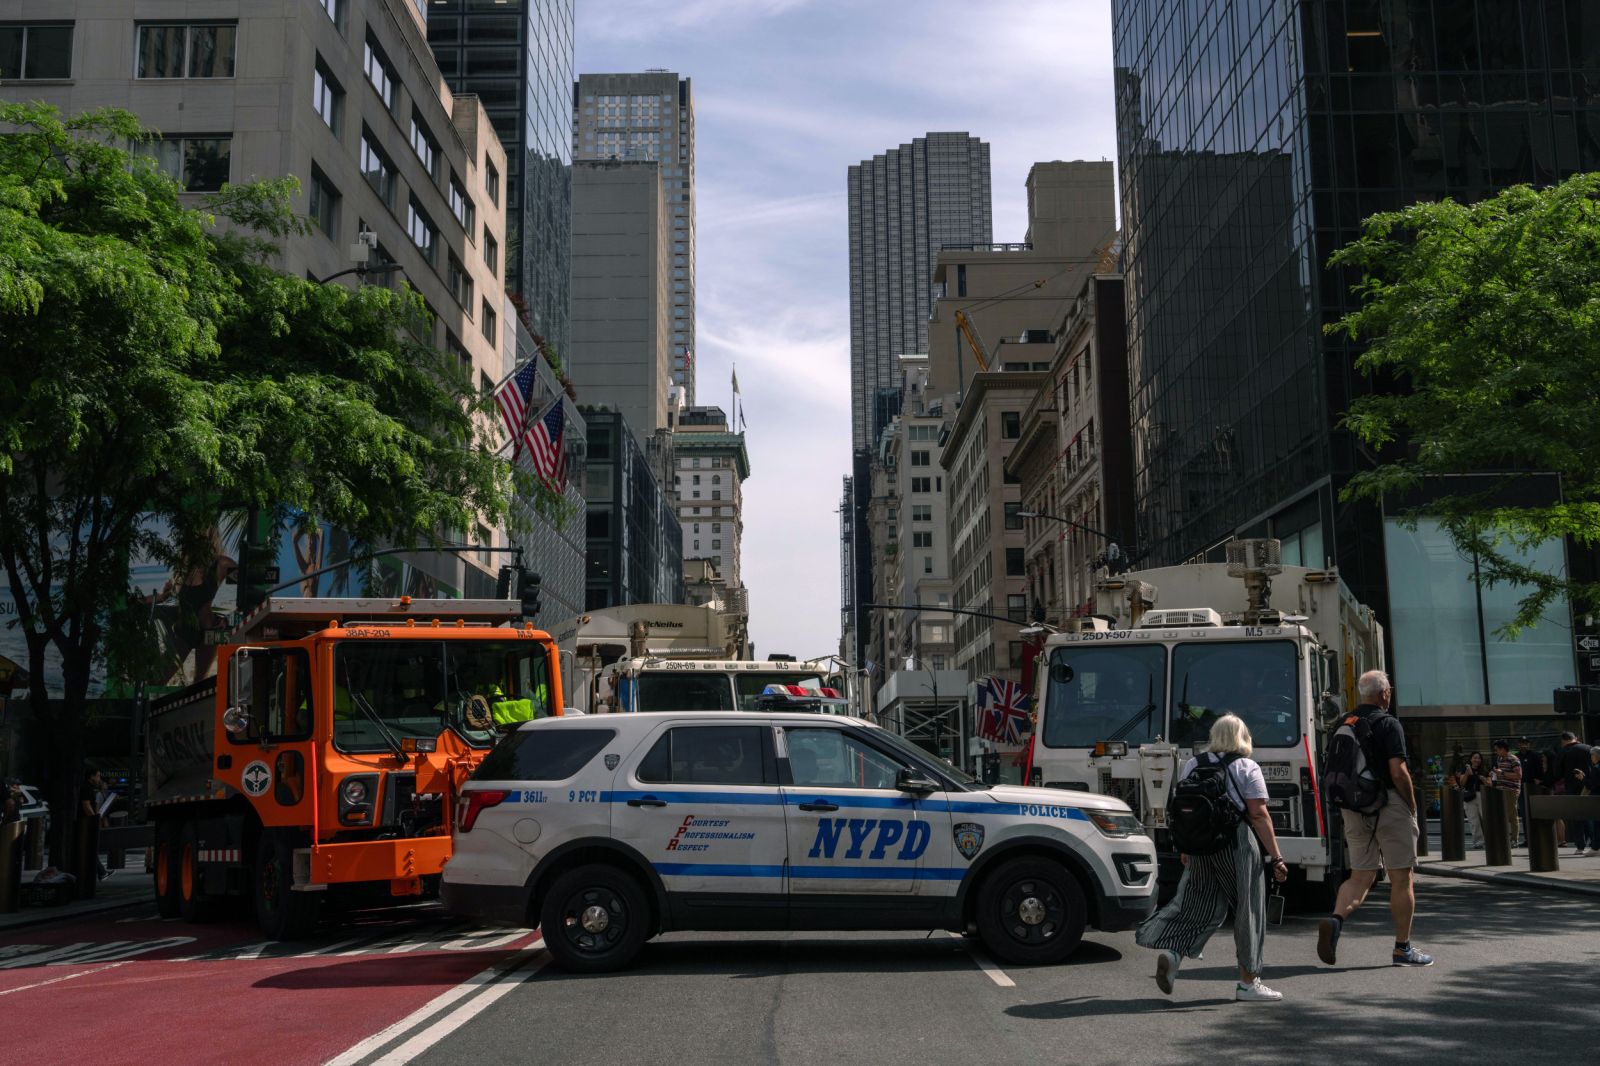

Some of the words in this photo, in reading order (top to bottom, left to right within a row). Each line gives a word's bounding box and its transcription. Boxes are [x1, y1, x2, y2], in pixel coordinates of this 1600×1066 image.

[1082, 631, 1132, 641] 25DY-507
[1245, 627, 1262, 637] M.5
[569, 790, 575, 802] 9
[578, 791, 597, 802] PCT
[1020, 804, 1067, 818] POLICE
[683, 815, 730, 826] COURTESY
[675, 827, 755, 839] PROFESSIONALISM
[666, 839, 709, 850] RESPECT
[808, 818, 931, 860] NYPD
